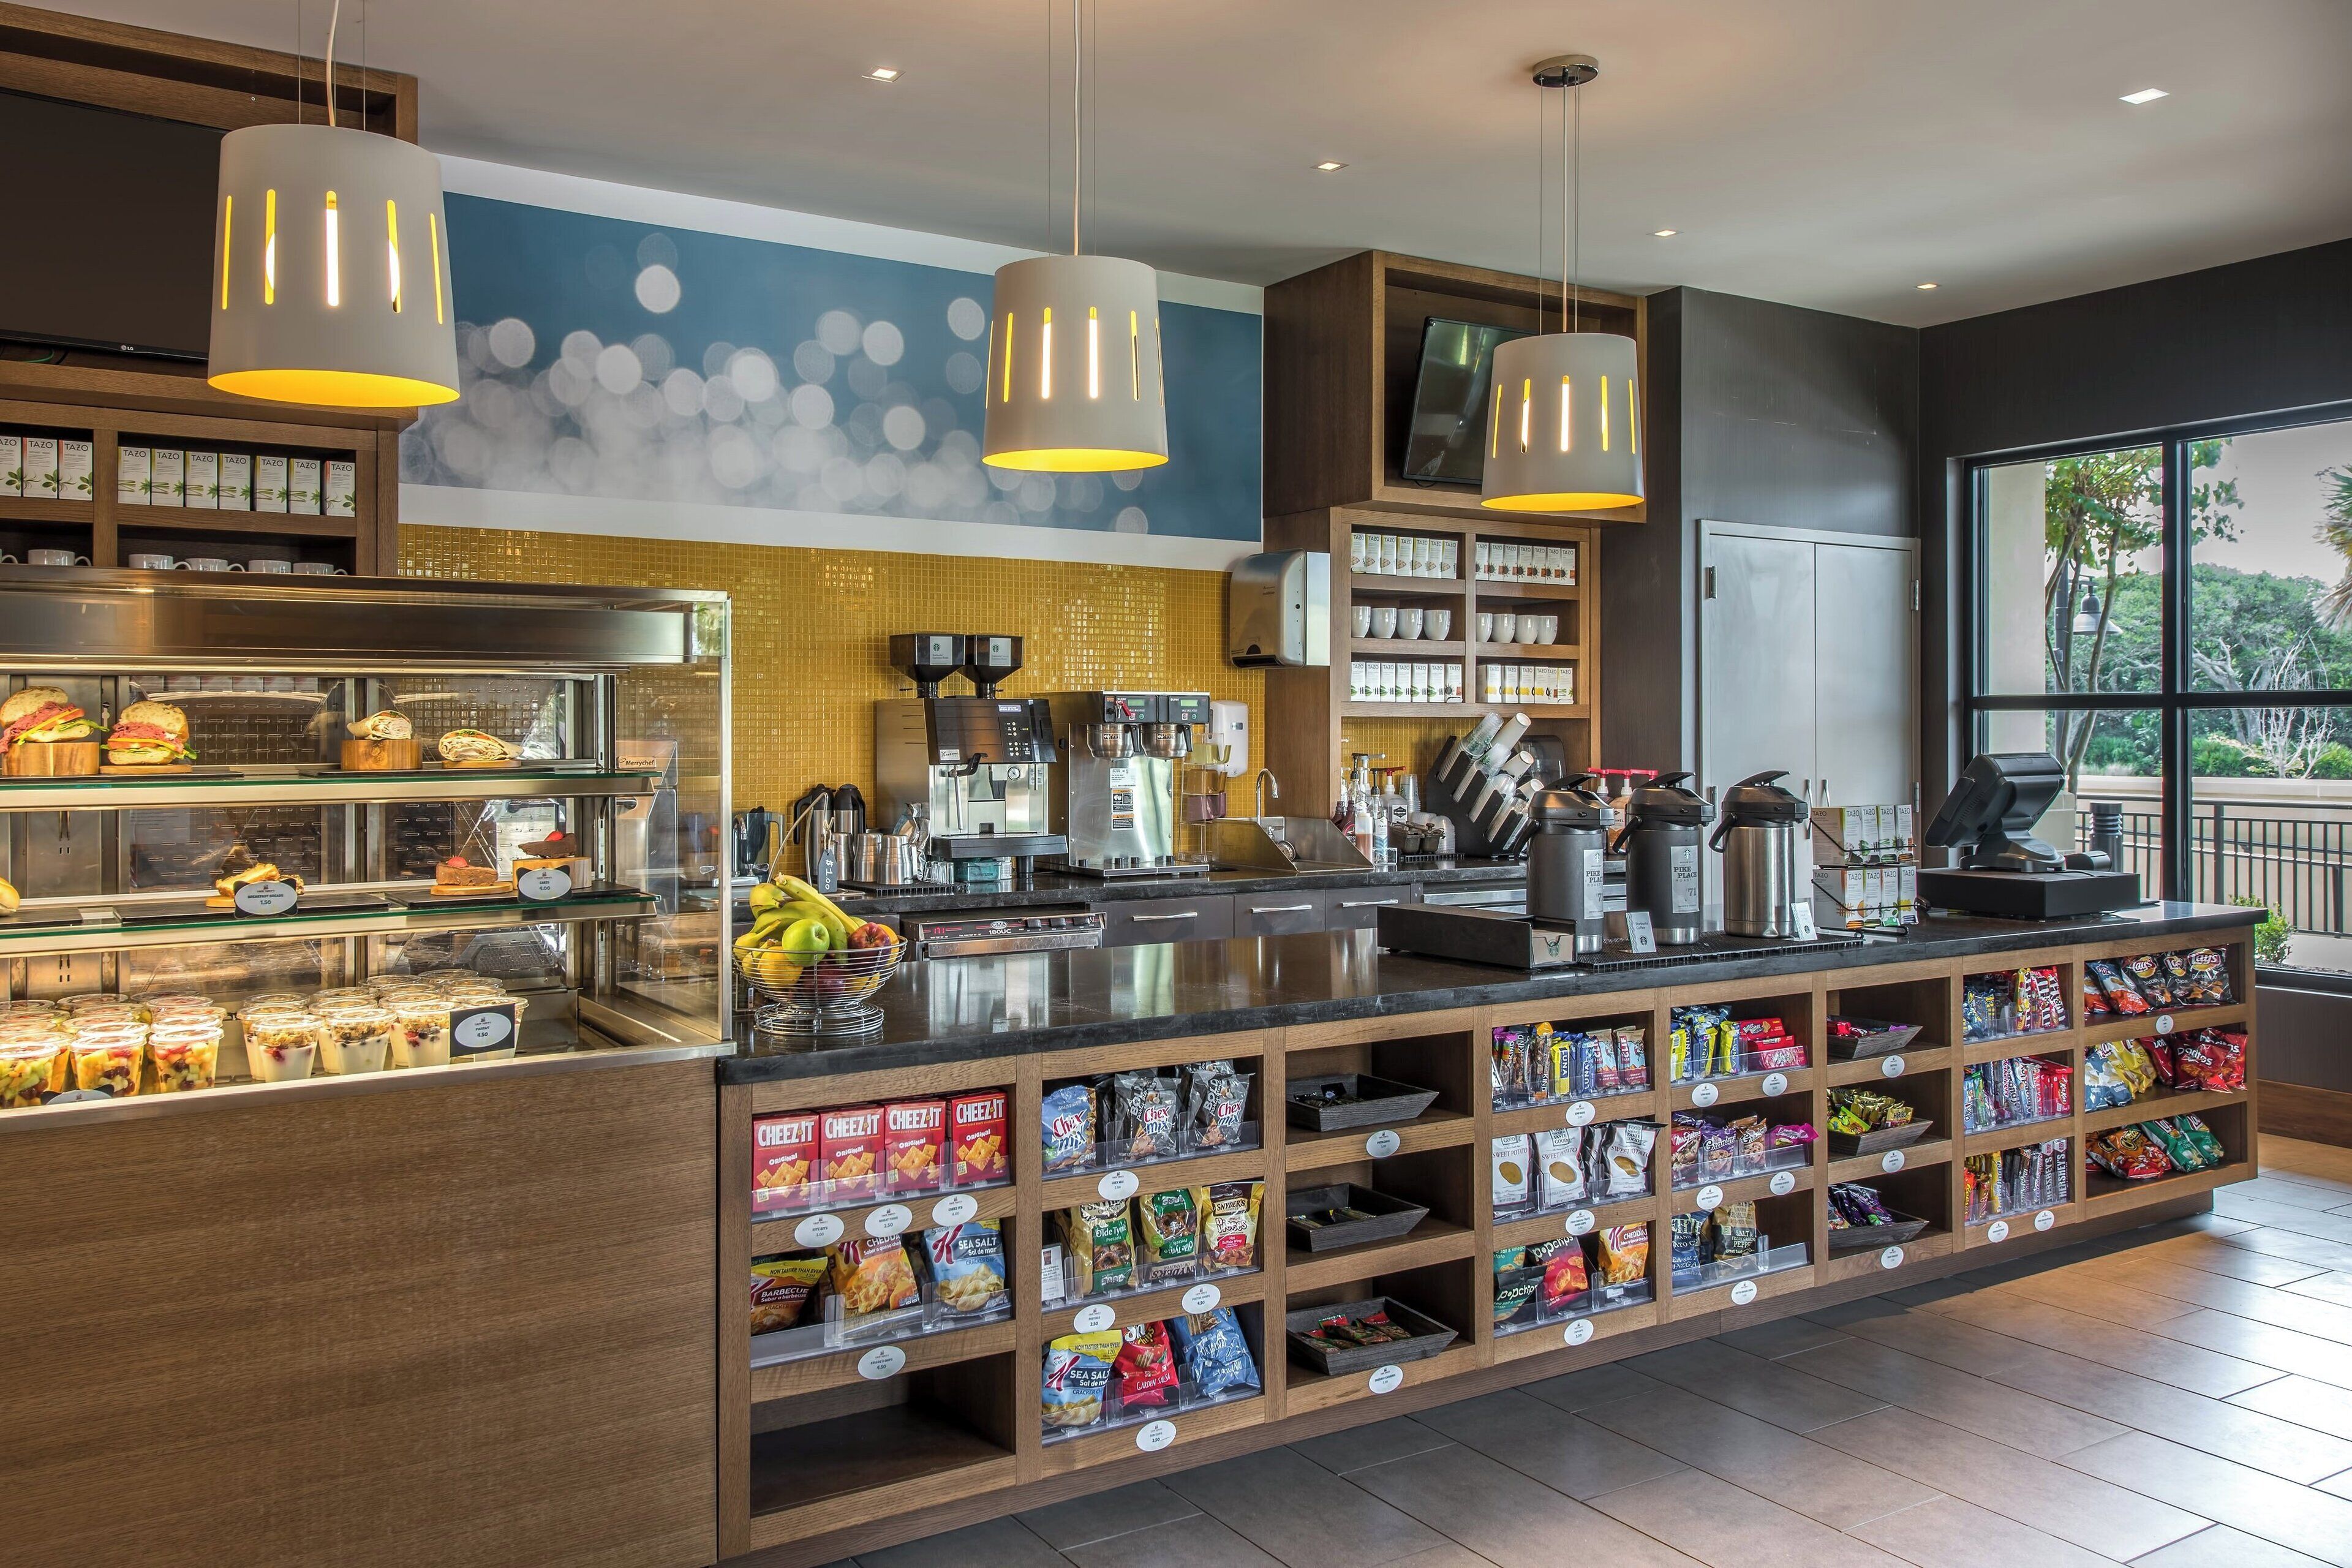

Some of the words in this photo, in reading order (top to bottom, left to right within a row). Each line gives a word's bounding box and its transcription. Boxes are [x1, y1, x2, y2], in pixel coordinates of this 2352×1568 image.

[28, 440, 53, 449] TAZO
[2191, 952, 2217, 965] Lay's
[2132, 959, 2152, 973] Lay's
[1620, 1038, 1629, 1058] CLIF
[2177, 1047, 2213, 1065] Doritos
[1203, 1079, 1219, 1111] BOLD
[1144, 1106, 1171, 1123] Chex
[1218, 1099, 1243, 1117] Chex
[1054, 1109, 1086, 1137] Chex
[1146, 1119, 1169, 1134] mix
[1218, 1114, 1239, 1127] mix
[1511, 1148, 1528, 1156] POTATO
[1559, 1147, 1578, 1156] POTATO
[2057, 1153, 2067, 1201] HERSHEY'S
[1216, 1199, 1246, 1212] SNYDER'S
[1096, 1227, 1112, 1238] Olde
[932, 1224, 963, 1265] K
[959, 1240, 974, 1250] SEA
[975, 1237, 997, 1248] SALT
[1182, 1240, 1193, 1252] Olde
[1532, 1236, 1574, 1262] popchips
[761, 1287, 809, 1298] BARBECUE
[1045, 1355, 1080, 1392] K
[1069, 1371, 1089, 1379] SEA
[1136, 1379, 1156, 1390] GARDEN
[1158, 1373, 1170, 1384] SALSA
